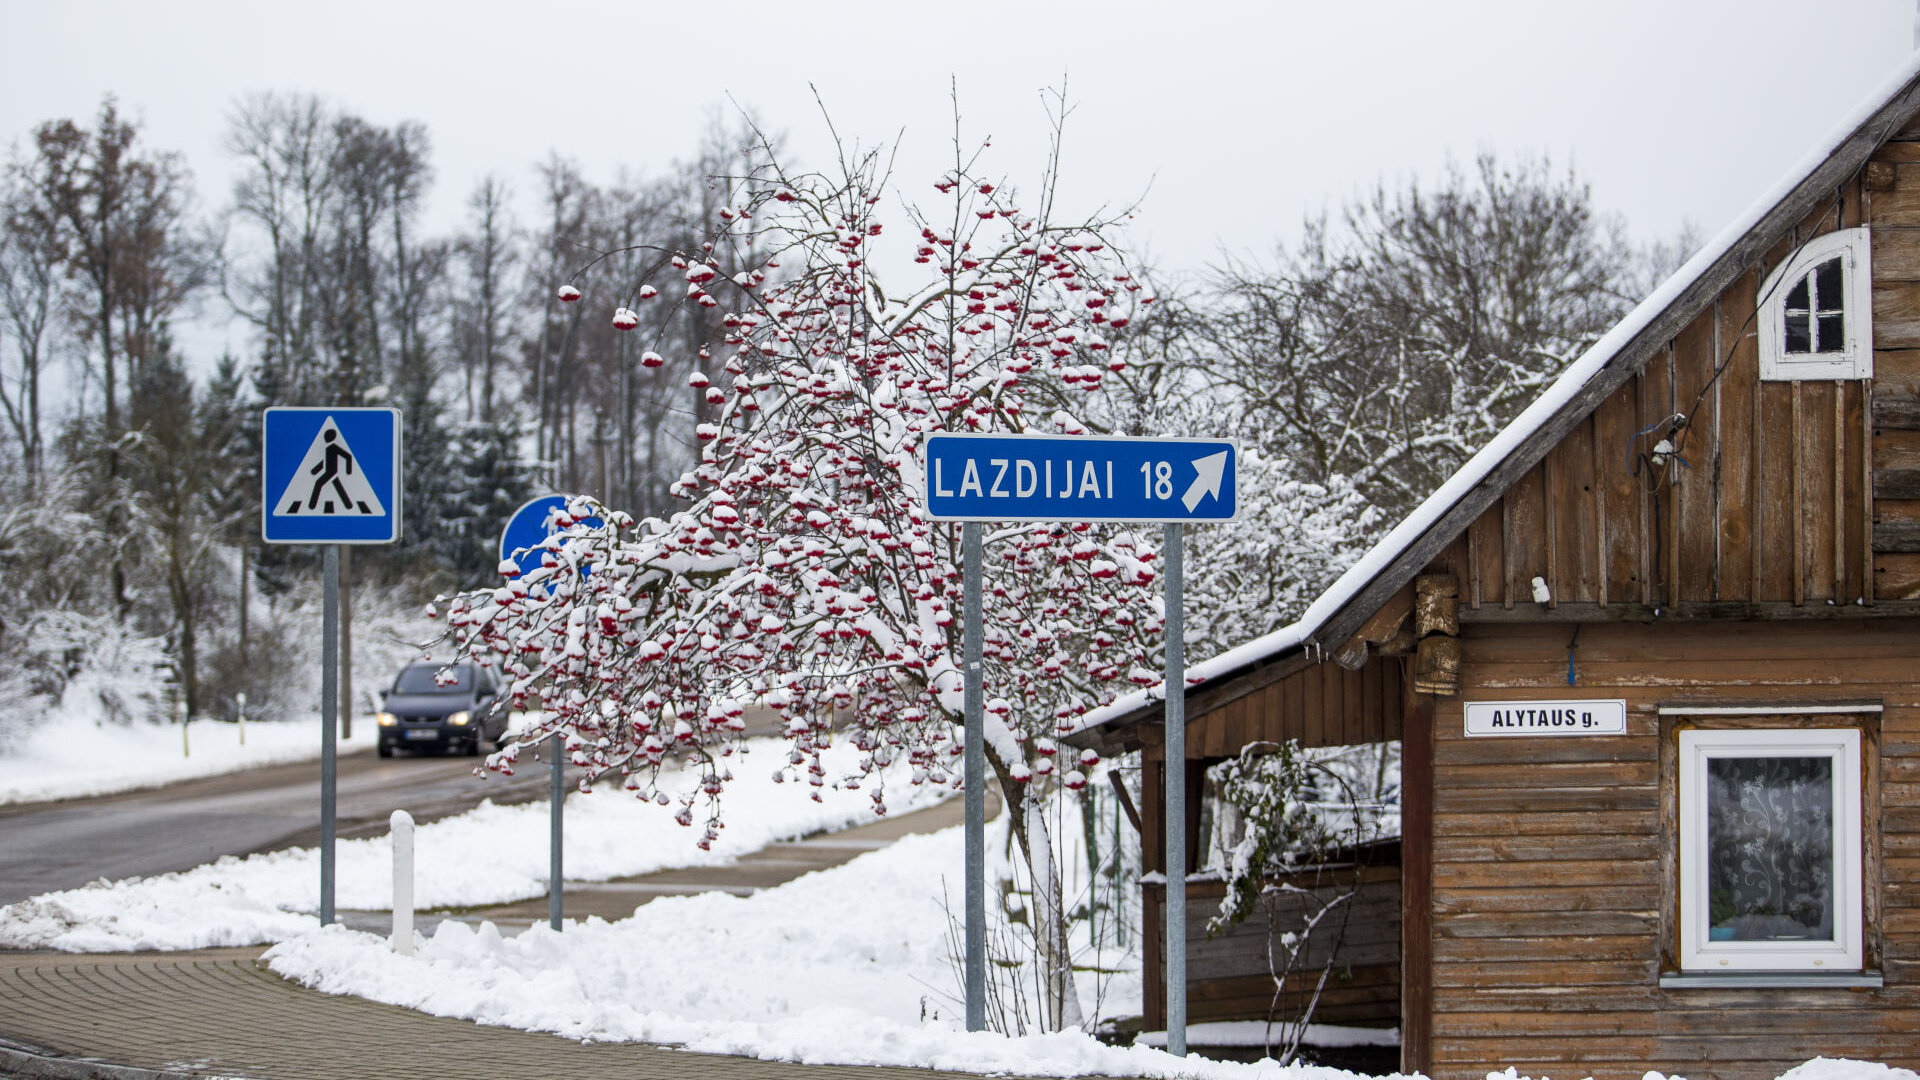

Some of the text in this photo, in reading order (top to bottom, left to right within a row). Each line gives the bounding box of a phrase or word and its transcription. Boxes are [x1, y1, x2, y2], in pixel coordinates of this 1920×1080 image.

[935, 458, 1173, 500] LAZDIJAI 18
[1492, 709, 1599, 728] ALYTAUS g.
